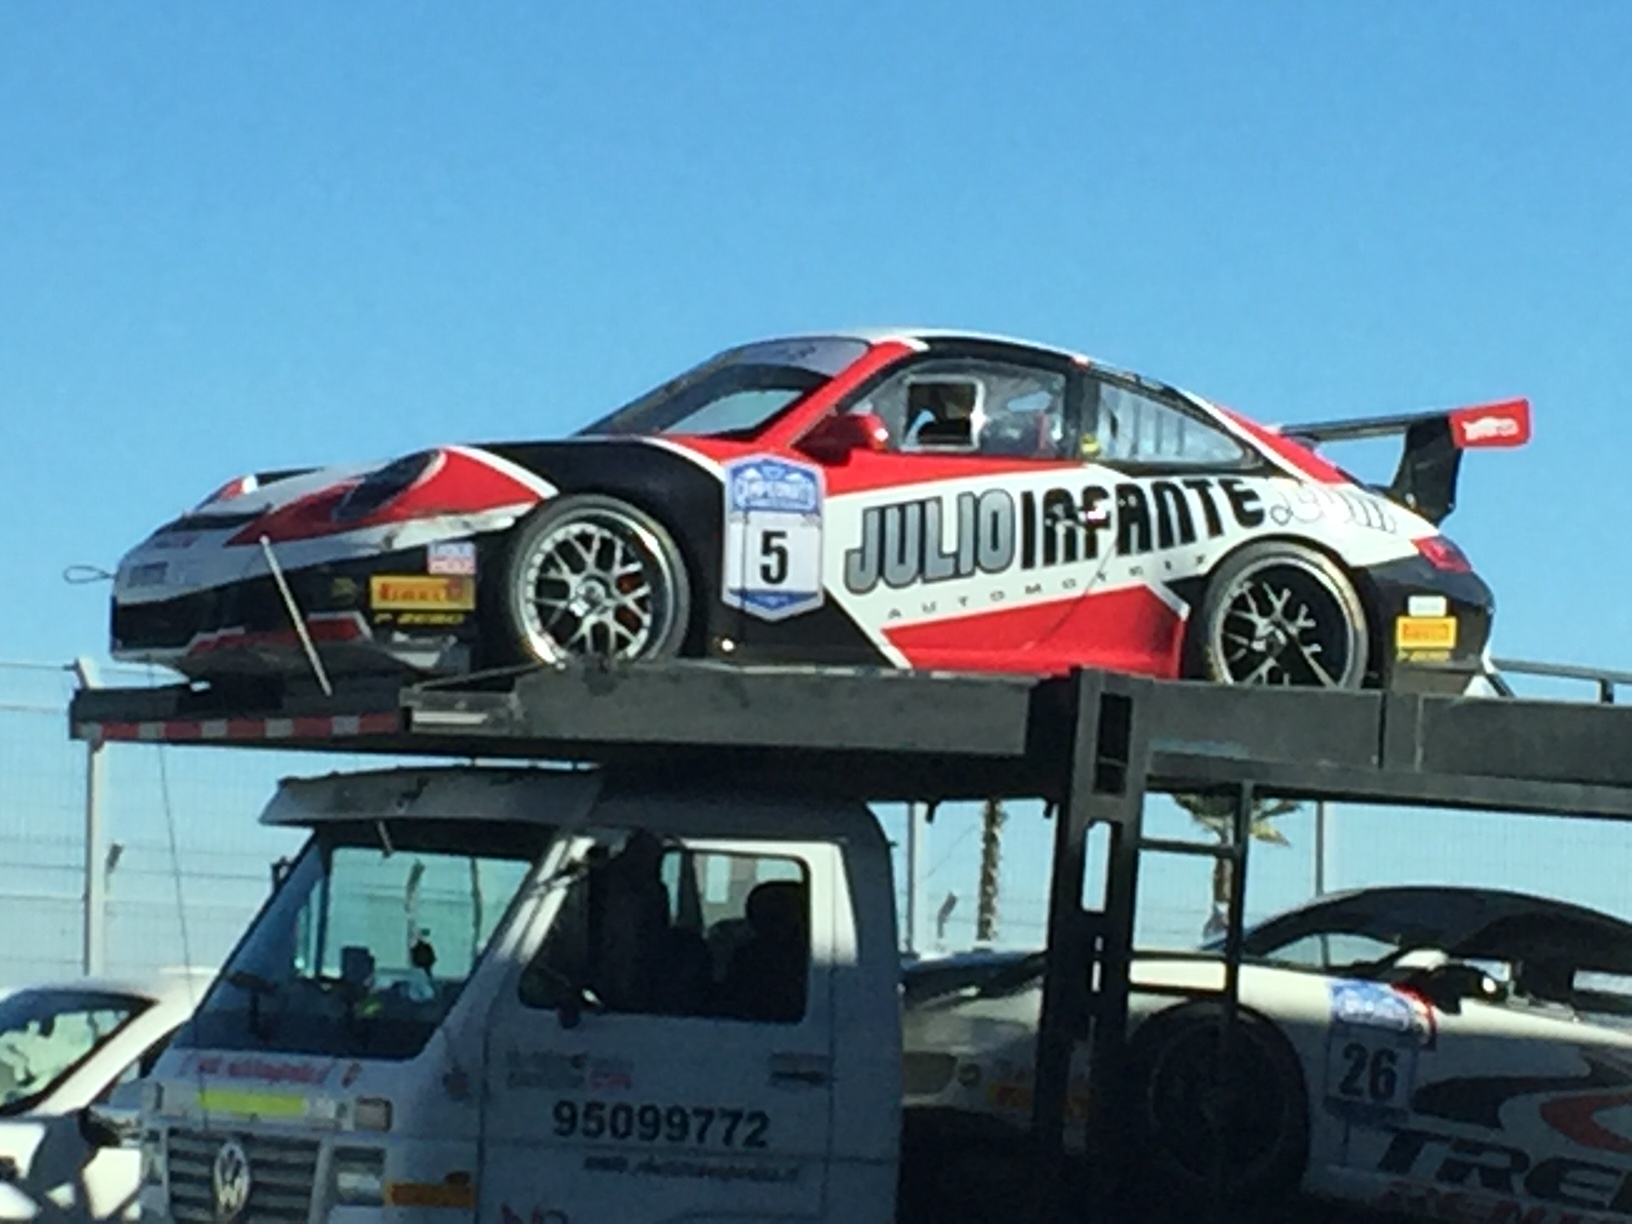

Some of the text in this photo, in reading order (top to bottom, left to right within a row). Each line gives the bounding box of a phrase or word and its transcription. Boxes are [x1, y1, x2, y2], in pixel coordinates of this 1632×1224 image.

[759, 529, 788, 585] 5
[843, 488, 1016, 594] JULIO
[1020, 474, 1267, 571] INFANTE
[1338, 1041, 1399, 1100] 26
[552, 1099, 771, 1148] 95099772
